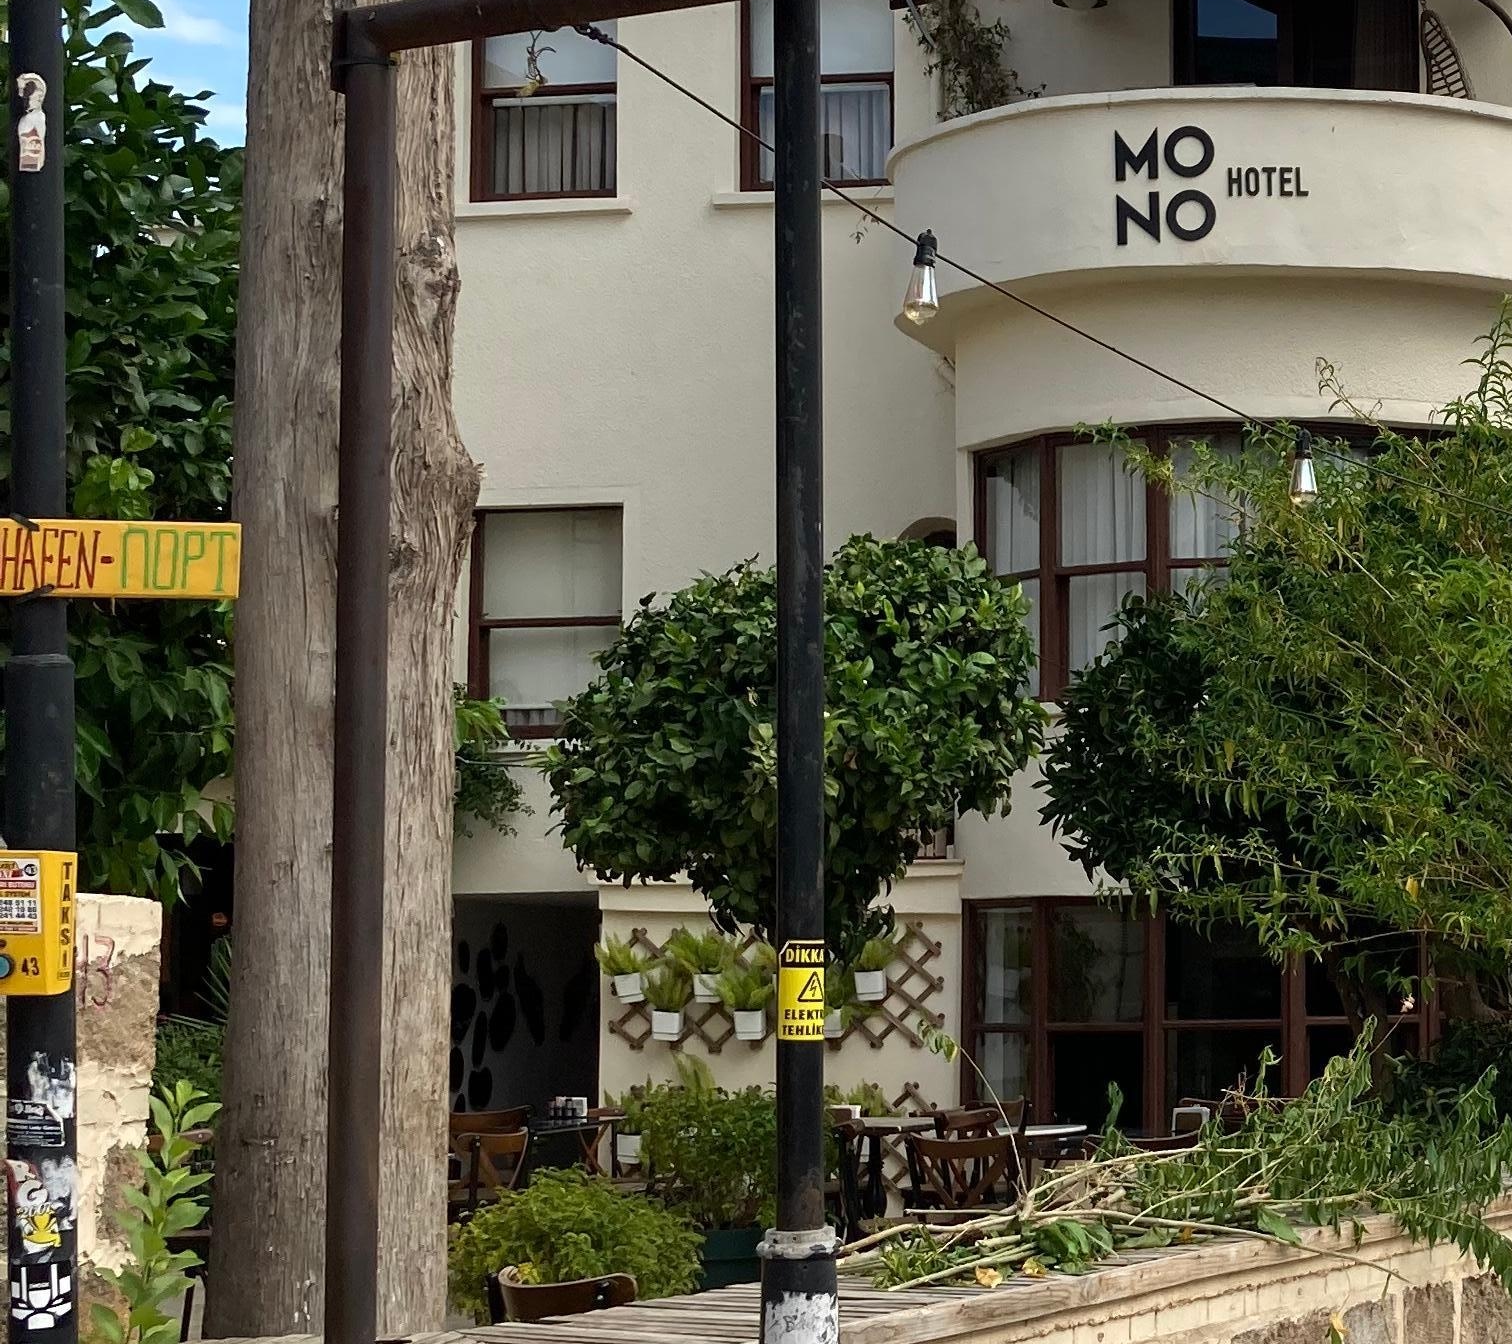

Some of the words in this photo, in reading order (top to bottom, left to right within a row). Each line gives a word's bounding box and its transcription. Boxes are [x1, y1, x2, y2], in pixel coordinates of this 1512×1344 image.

[1114, 125, 1215, 182] MO
[1227, 166, 1309, 197] HOTEL
[1116, 189, 1216, 245] NO
[21, 957, 40, 976] 43
[785, 945, 824, 963] DİKKA
[784, 1008, 824, 1021] ELEKT
